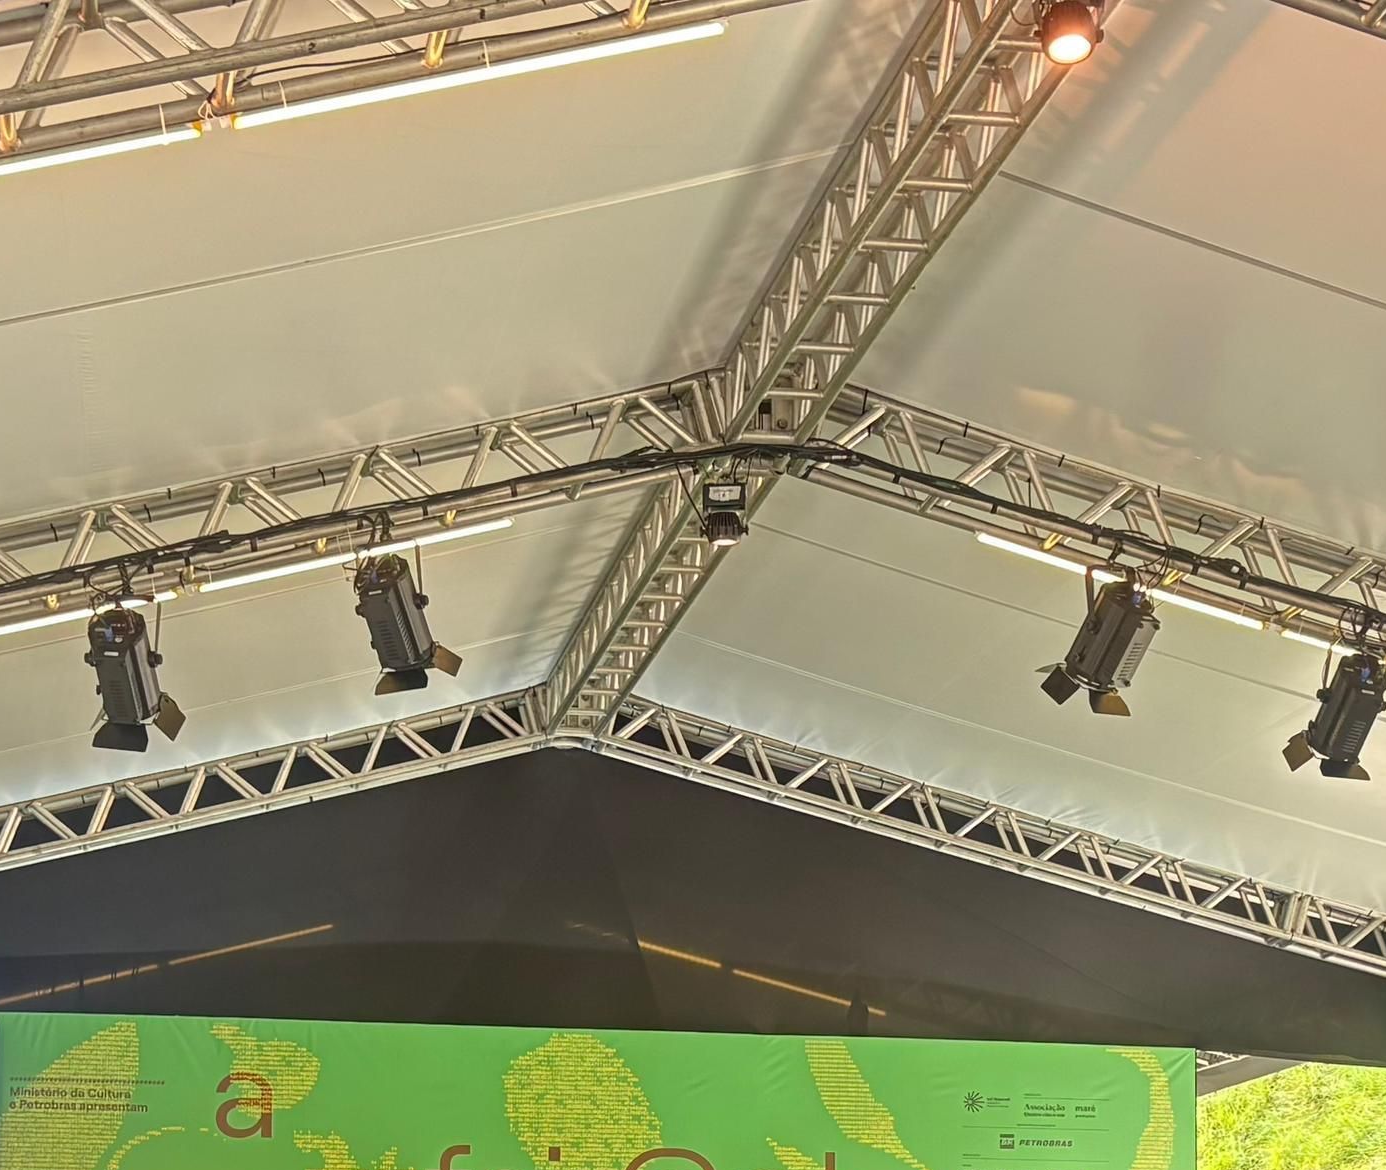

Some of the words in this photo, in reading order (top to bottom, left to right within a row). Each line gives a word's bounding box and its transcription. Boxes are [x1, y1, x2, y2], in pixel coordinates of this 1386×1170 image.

[9, 1086, 68, 1098] Ministério
[70, 1088, 85, 1098] da
[87, 1088, 132, 1099] Cultura
[19, 1100, 79, 1111] Petrobras
[80, 1102, 149, 1113] apresentam
[215, 1071, 273, 1139] a
[1019, 1139, 1073, 1148] PETROBRAS
